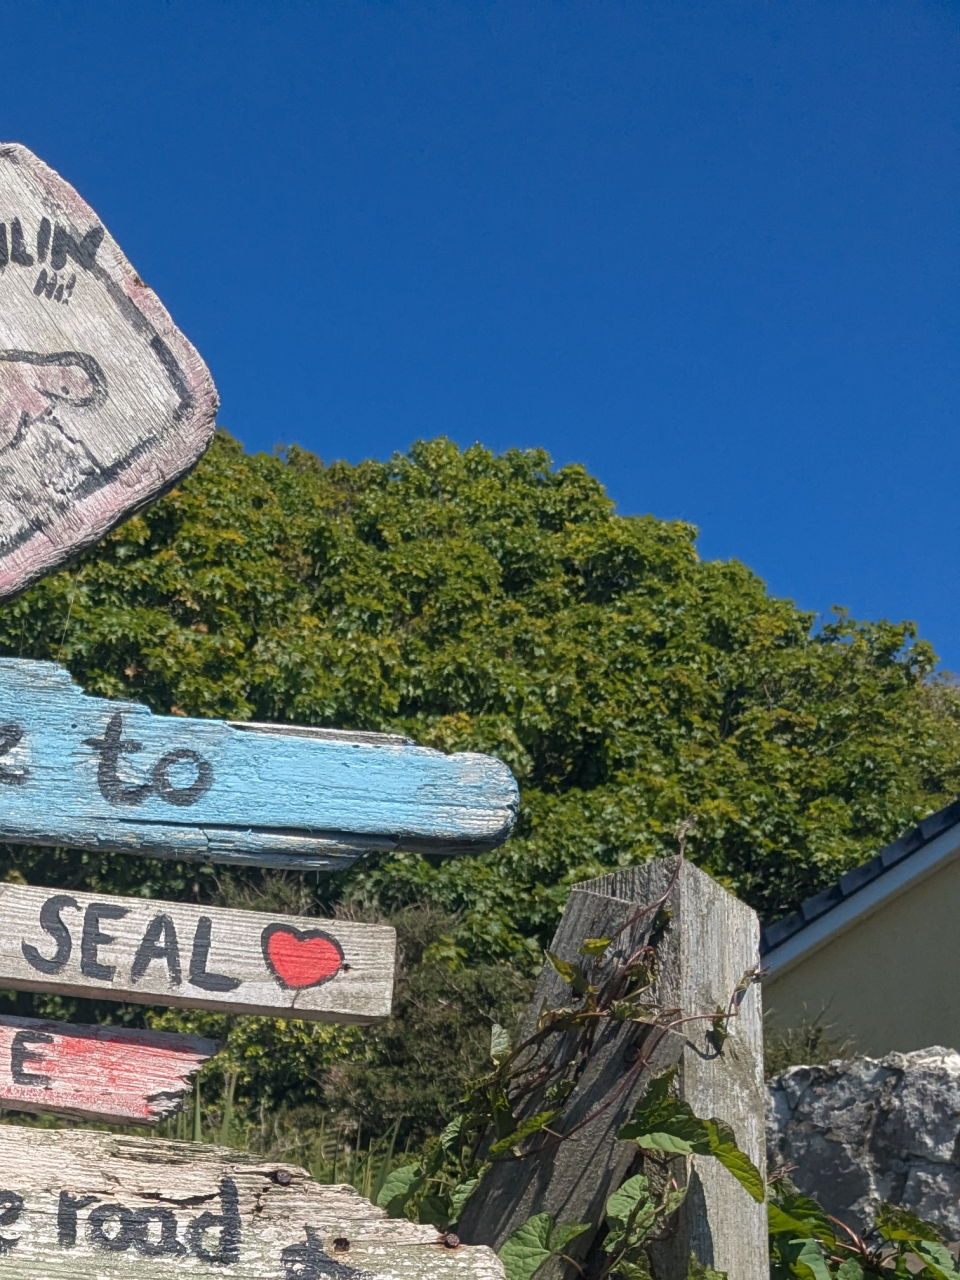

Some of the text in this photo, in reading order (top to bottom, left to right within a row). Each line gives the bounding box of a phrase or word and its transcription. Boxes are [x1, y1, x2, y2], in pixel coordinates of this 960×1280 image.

[82, 710, 215, 806] to
[21, 894, 242, 993] SEAL
[57, 1175, 241, 1265] road
